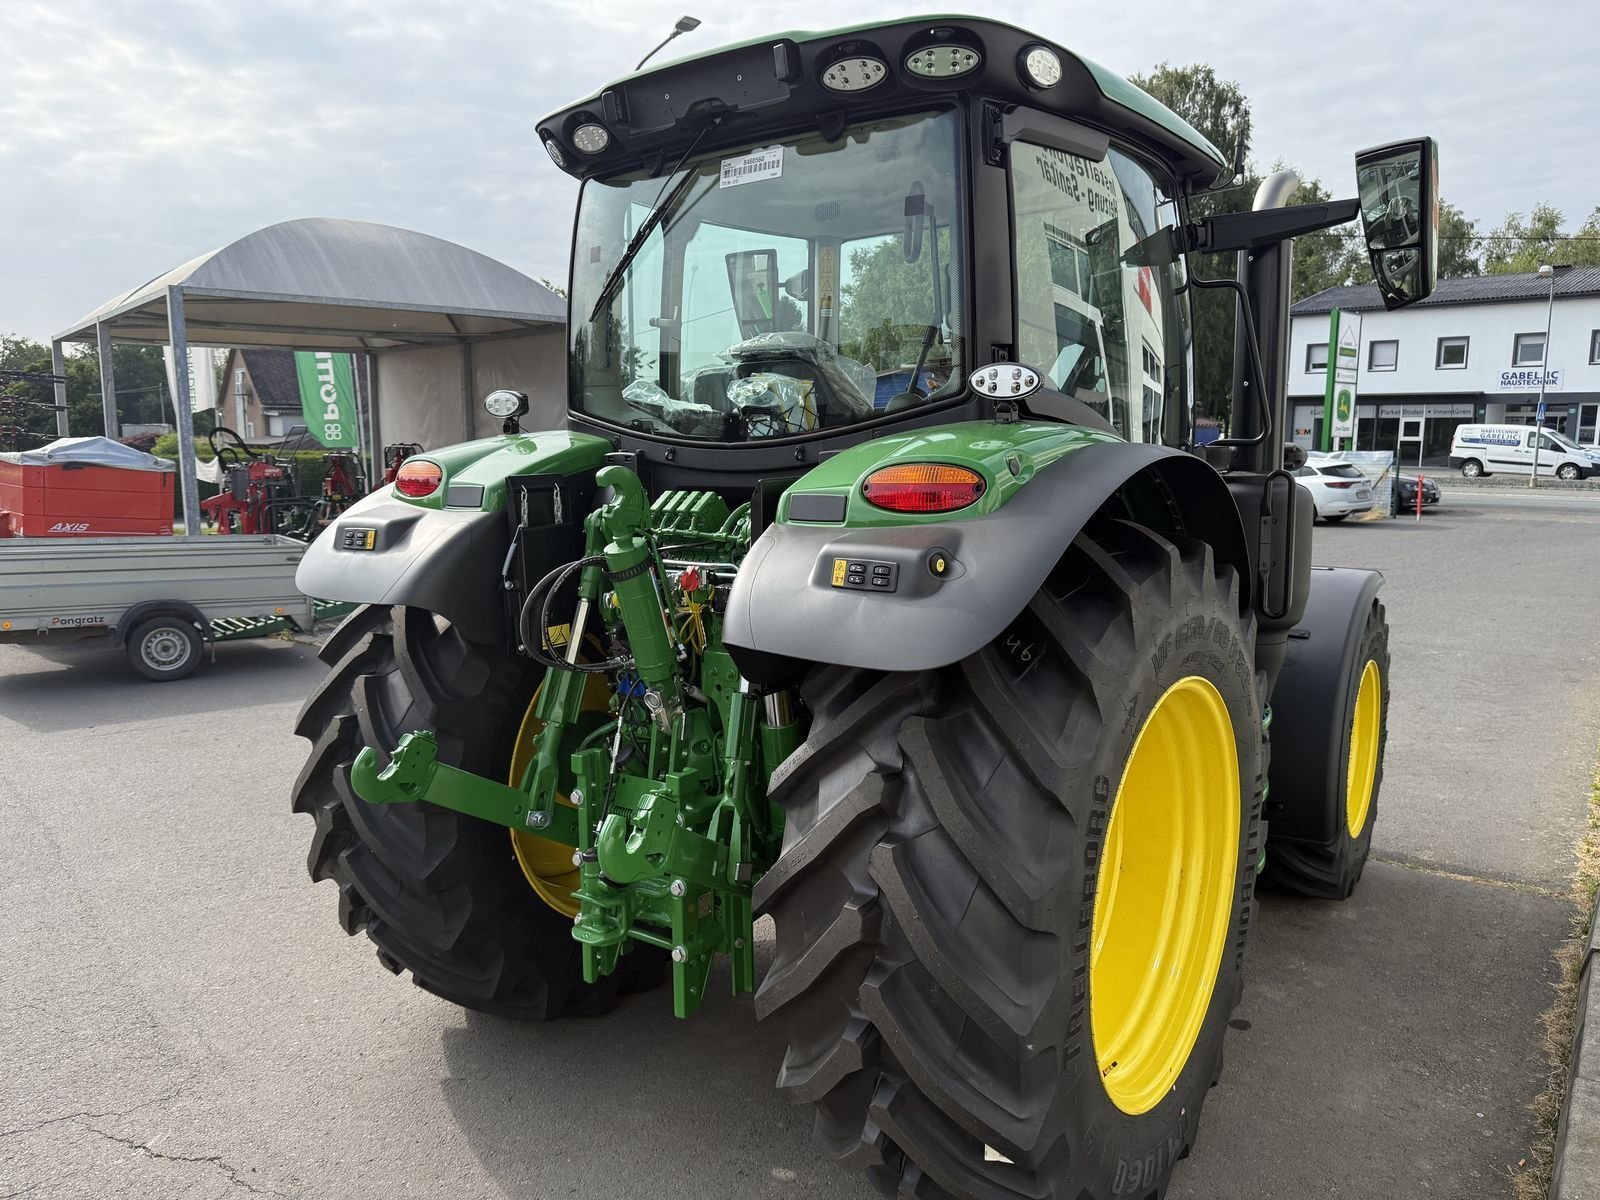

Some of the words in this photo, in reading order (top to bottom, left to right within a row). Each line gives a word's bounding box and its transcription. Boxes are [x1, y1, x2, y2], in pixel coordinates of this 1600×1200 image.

[1501, 370, 1560, 380] GABELIC
[50, 522, 90, 532] AXIS
[52, 615, 105, 627] Pongratz
